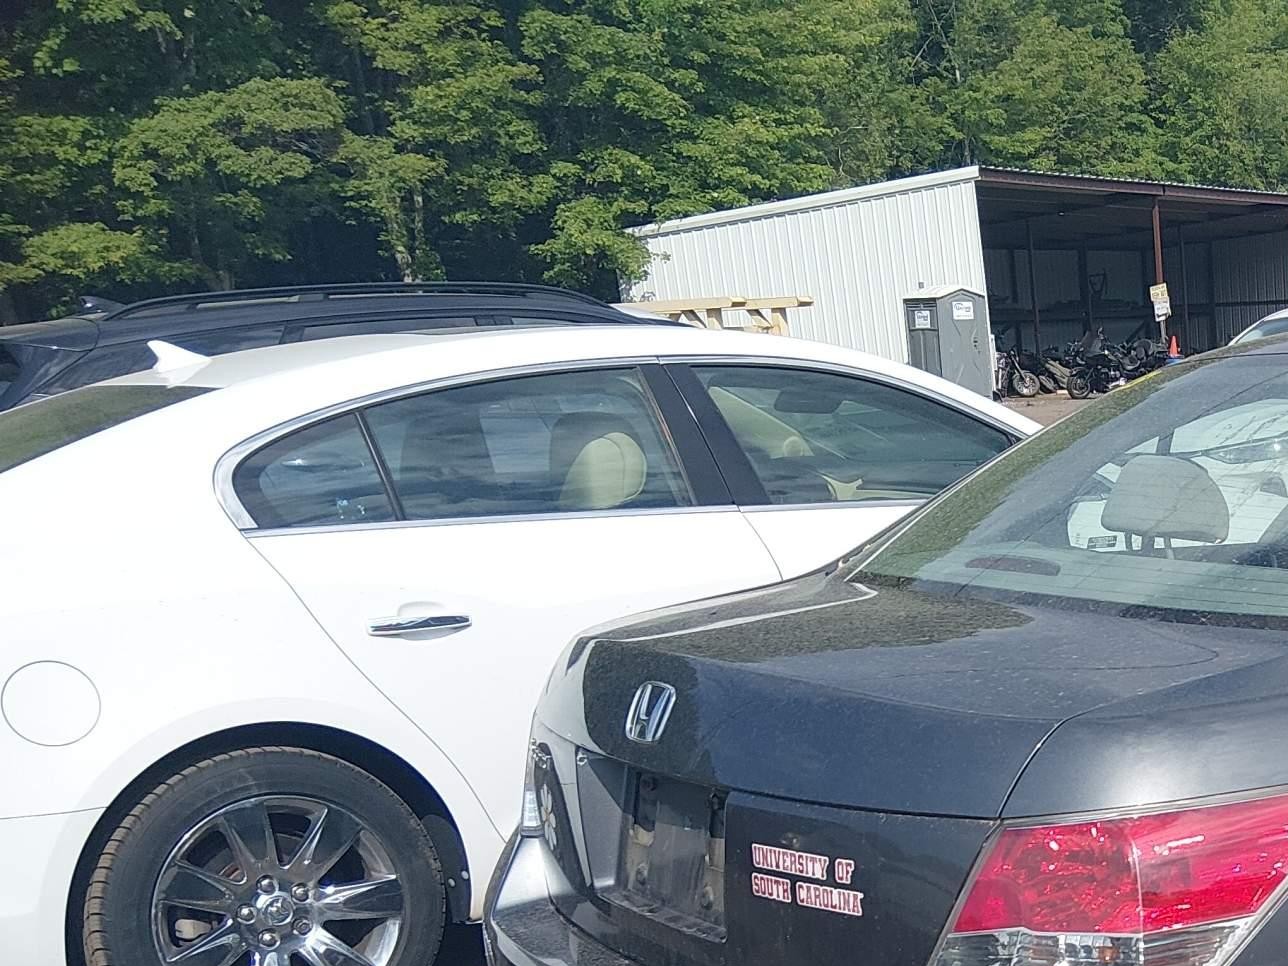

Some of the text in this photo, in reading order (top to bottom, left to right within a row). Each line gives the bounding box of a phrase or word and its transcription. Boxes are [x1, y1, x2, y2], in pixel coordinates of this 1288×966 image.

[753, 845, 853, 882] UNIVERSITY OF
[753, 874, 862, 914] SOUTH CAROLINA
